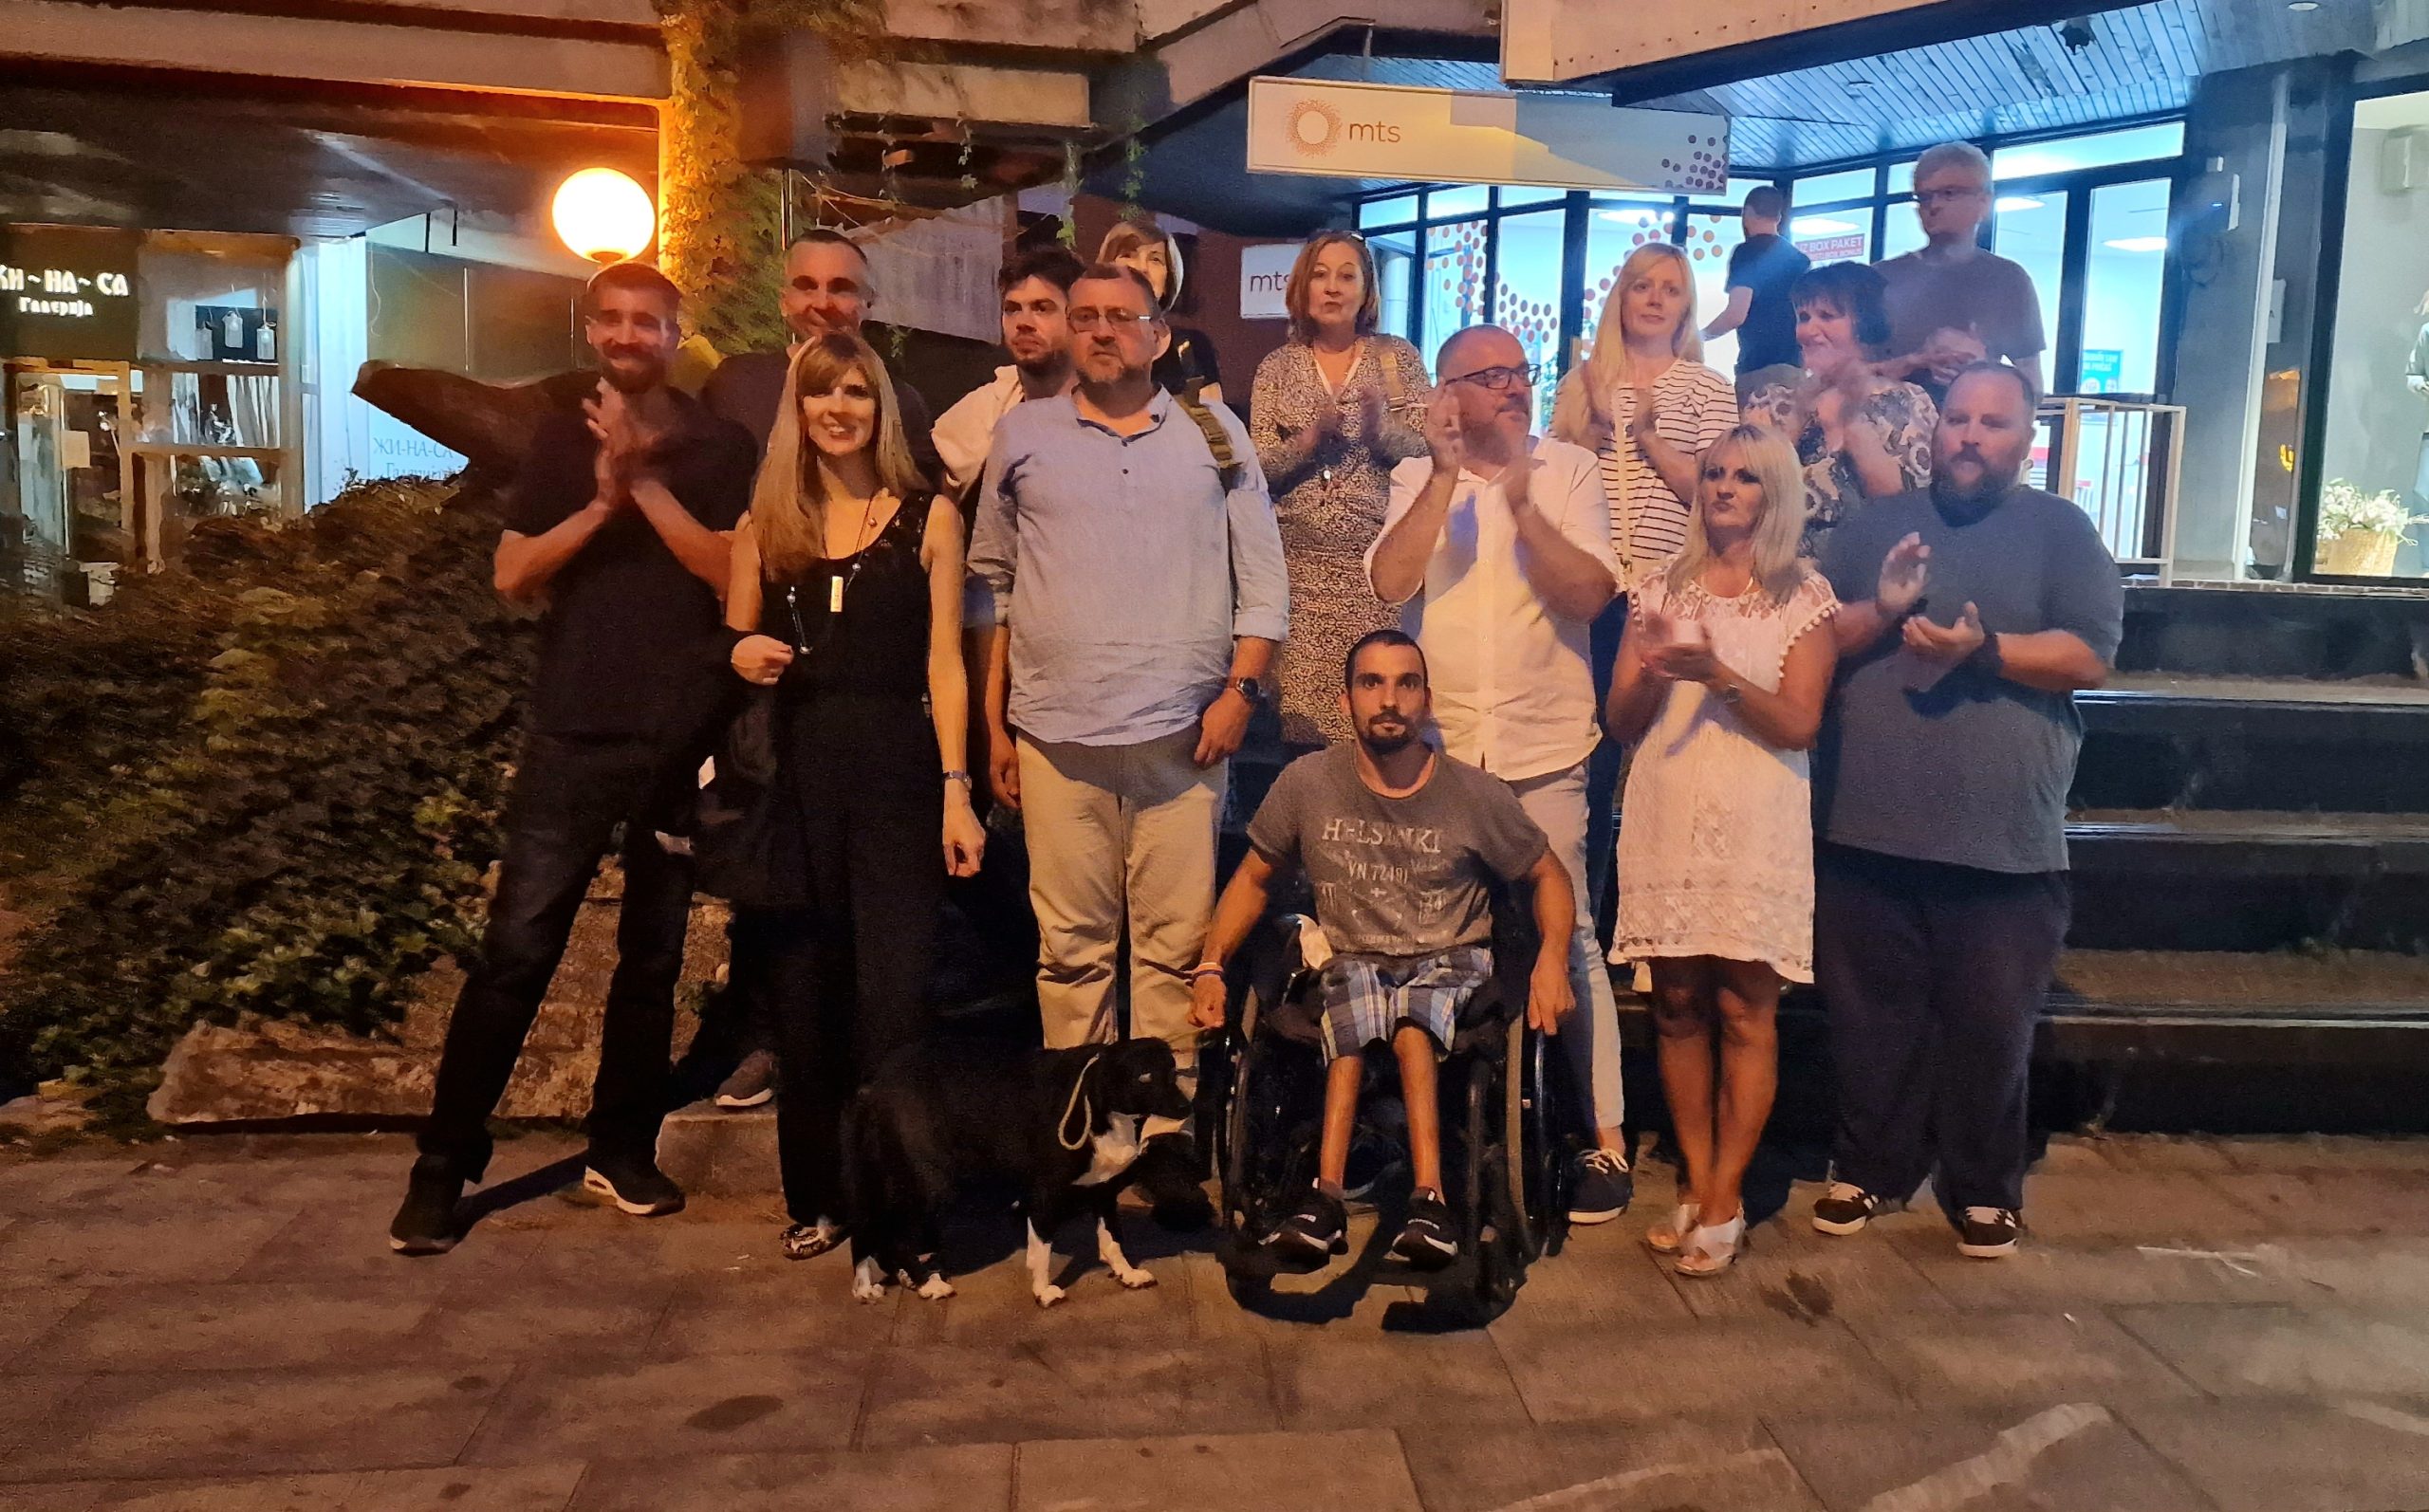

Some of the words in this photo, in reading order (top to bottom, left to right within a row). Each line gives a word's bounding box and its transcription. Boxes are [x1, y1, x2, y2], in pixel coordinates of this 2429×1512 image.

[1349, 120, 1401, 143] mts
[1809, 241, 1829, 252] BOX
[1830, 235, 1863, 249] PAKET
